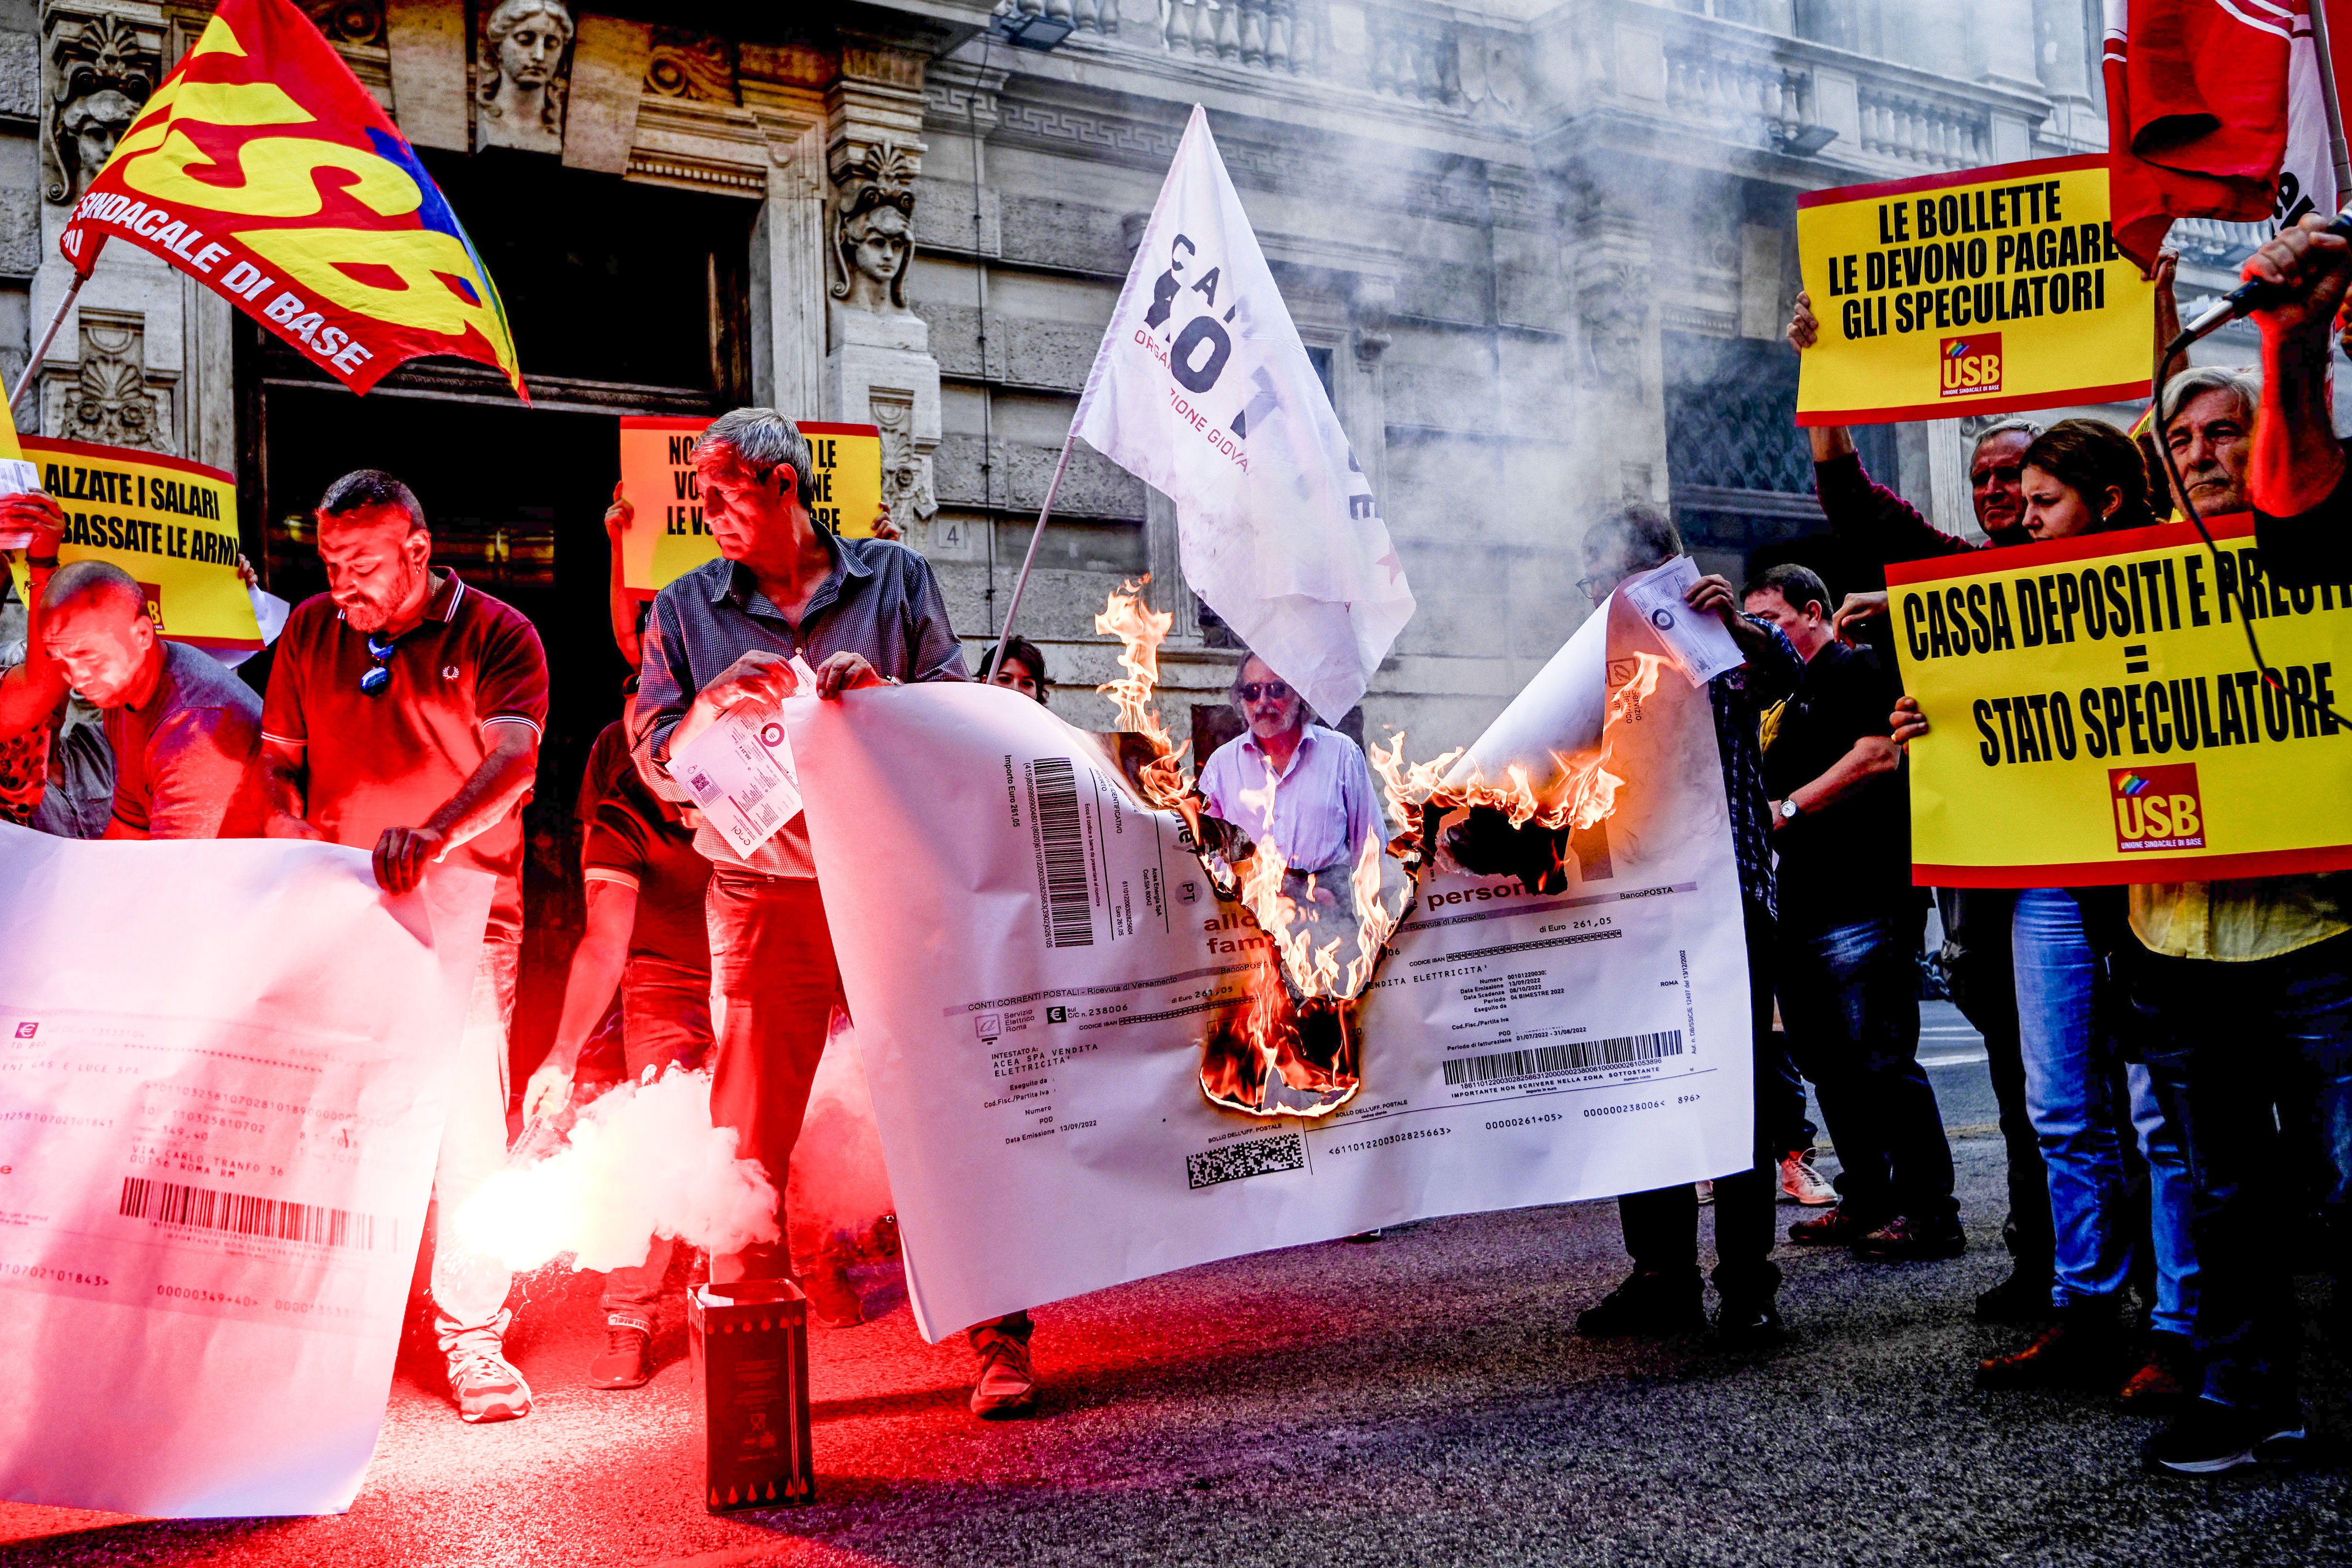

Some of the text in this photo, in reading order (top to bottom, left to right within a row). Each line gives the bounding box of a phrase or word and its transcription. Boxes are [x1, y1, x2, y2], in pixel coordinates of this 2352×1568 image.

[1879, 181, 2061, 244] LE BOLLETTE
[1829, 254, 1858, 296] LE
[1866, 237, 1987, 293] DEVONO
[1842, 269, 2104, 341] GLI SPECULATORI
[220, 261, 275, 302] DI
[263, 292, 373, 375] BASE
[1944, 354, 2000, 388] USB
[818, 439, 837, 468] LE
[45, 463, 133, 506] ALZATE
[138, 475, 145, 507] I
[151, 478, 220, 521] SALARI
[668, 506, 686, 535] LE
[167, 525, 187, 559] LE
[946, 529, 959, 544] 4
[1903, 577, 2014, 661] CASSA
[2015, 559, 2181, 647] DEPOSITI
[2184, 554, 2209, 627] E
[1632, 690, 1642, 721] Servizio
[1973, 662, 2340, 767] STATO SPECULATORE
[1004, 755, 1013, 784] Importo
[1011, 805, 1020, 827] 261,05
[1110, 788, 1123, 834] IDENTIFICATIVO
[2116, 795, 2200, 839] USB
[2121, 841, 2143, 849] UNIONE
[2144, 840, 2177, 848] SINDACALE
[1153, 882, 1161, 904] Energia
[1182, 883, 1196, 902] PT
[1410, 920, 1441, 931] Ricevuta
[1452, 913, 1487, 924] Accredito
[1620, 886, 1674, 899] BancoPOSTA
[1548, 923, 1567, 932] Euro
[1573, 917, 1612, 929] 261,05
[1679, 950, 1688, 979] 13/12/2002
[1475, 983, 1504, 992] Emissione
[1509, 977, 1540, 987] 13/09/2022
[1479, 976, 1503, 984] Numero
[968, 1001, 995, 1011] CONTI
[997, 993, 1041, 1006] CORRENTI
[1044, 989, 1079, 999] POSTALI
[1087, 986, 1121, 995] Ricevuta
[1131, 976, 1177, 989] Versamento
[1194, 986, 1233, 999] 261,05
[1477, 990, 1505, 999] Scadenza
[1510, 984, 1542, 994] 08/10/2022
[1519, 990, 1549, 999] BIMESTRE
[1004, 1009, 1033, 1019] Servizio
[1006, 1015, 1035, 1026] Elettrico
[1089, 1004, 1128, 1016] 238006
[1006, 1023, 1027, 1033] Roma
[1079, 1022, 1102, 1030] CODICE
[1452, 1018, 1500, 1030] Cod.Fisc./Partita
[1477, 1037, 1512, 1047] fatturazione
[1516, 1031, 1548, 1041] 01/07/2022
[1554, 1027, 1587, 1036] 31/08/2022
[992, 1048, 1030, 1060] INTESTATO
[994, 1044, 1098, 1068] ACEA SPA VENDITA
[2, 1061, 139, 1075] ENI GAS E LUCE SPA
[994, 1056, 1070, 1077] ELETTRICITA'
[1010, 1080, 1038, 1091] Eseguito
[1452, 1087, 1498, 1098] IMPORTANTE
[1519, 1080, 1554, 1089] SCRIVERE
[1608, 1066, 1660, 1078] SOTTOSTANTE
[984, 1092, 1038, 1108] Cod.Fisc./Partita
[1025, 1105, 1052, 1115] Numero
[1335, 1100, 1408, 1118] BOLLO POSTALE
[1039, 1116, 1053, 1125] POD
[1005, 1120, 1097, 1145] Data Emissione 13/09/2022
[1208, 1123, 1282, 1144] BOLLO POSTALE
[133, 1145, 284, 1176] VIA CARLO TRANFO 36
[180, 1162, 235, 1179] ROMA RM
